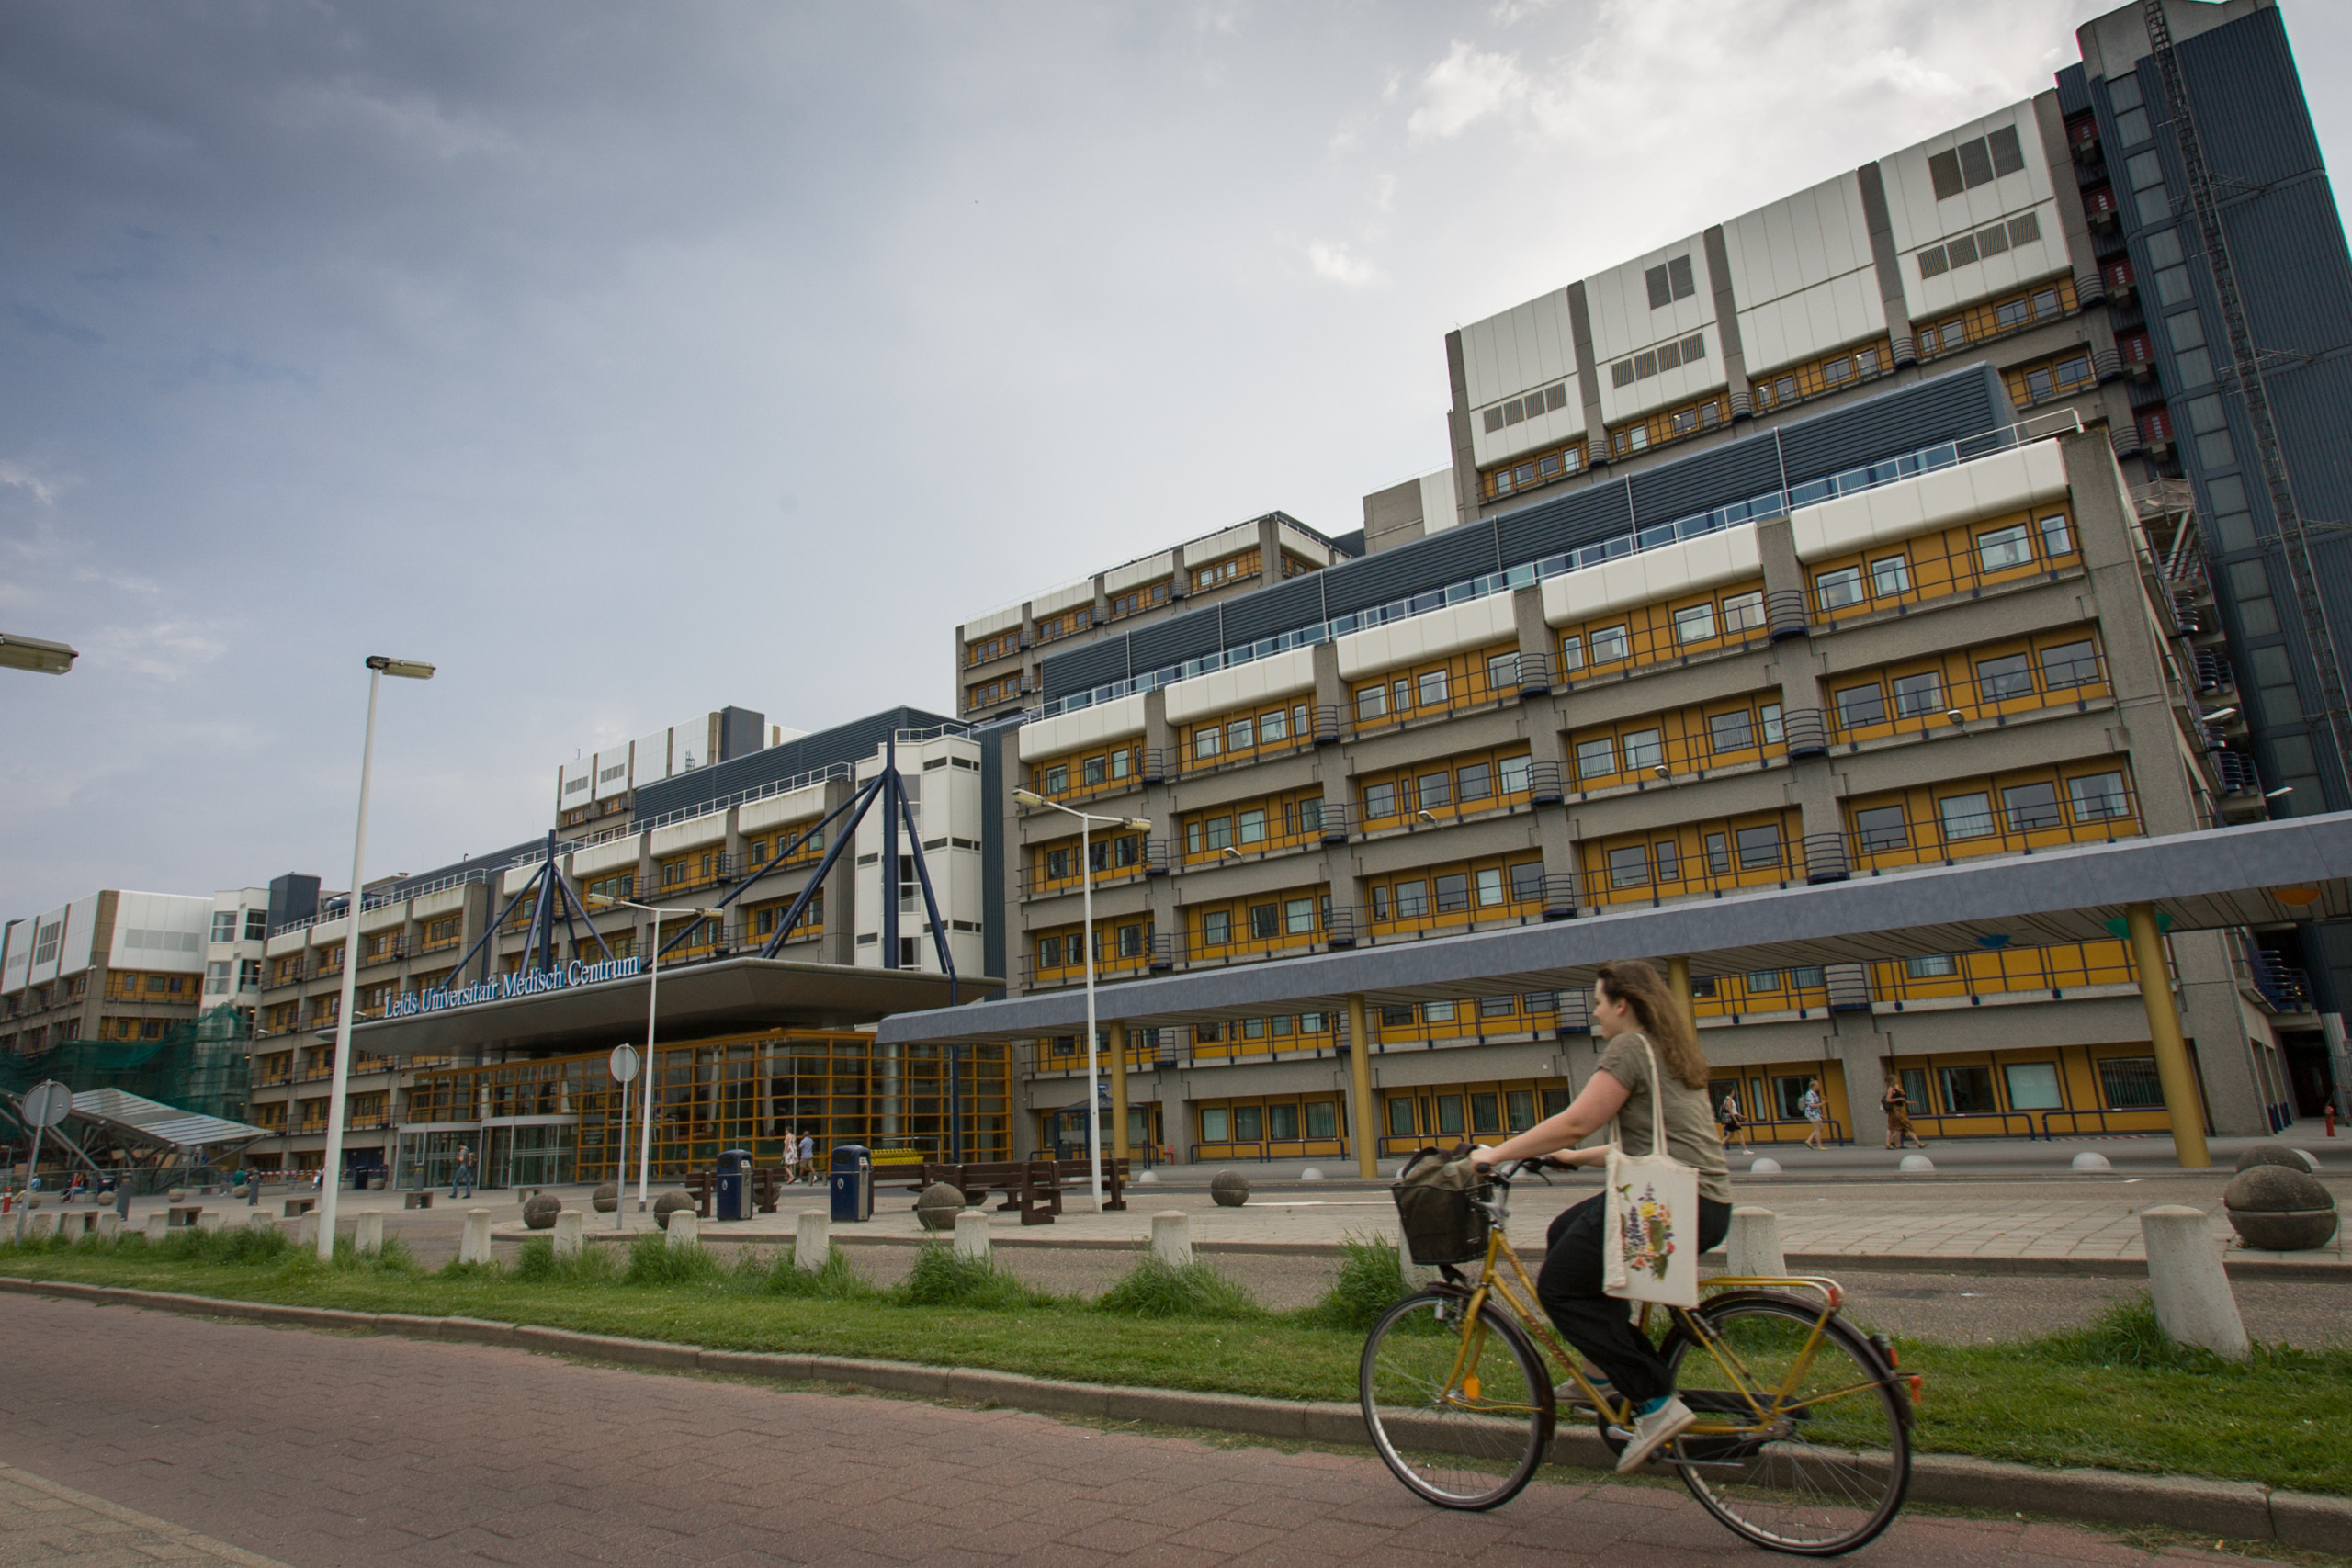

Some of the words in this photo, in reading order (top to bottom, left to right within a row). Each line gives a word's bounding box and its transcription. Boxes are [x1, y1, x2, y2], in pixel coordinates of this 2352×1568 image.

[384, 991, 419, 1018] Leids
[422, 976, 501, 1012] Universitair
[503, 963, 565, 998] Medisch
[568, 955, 641, 987] Centrum
